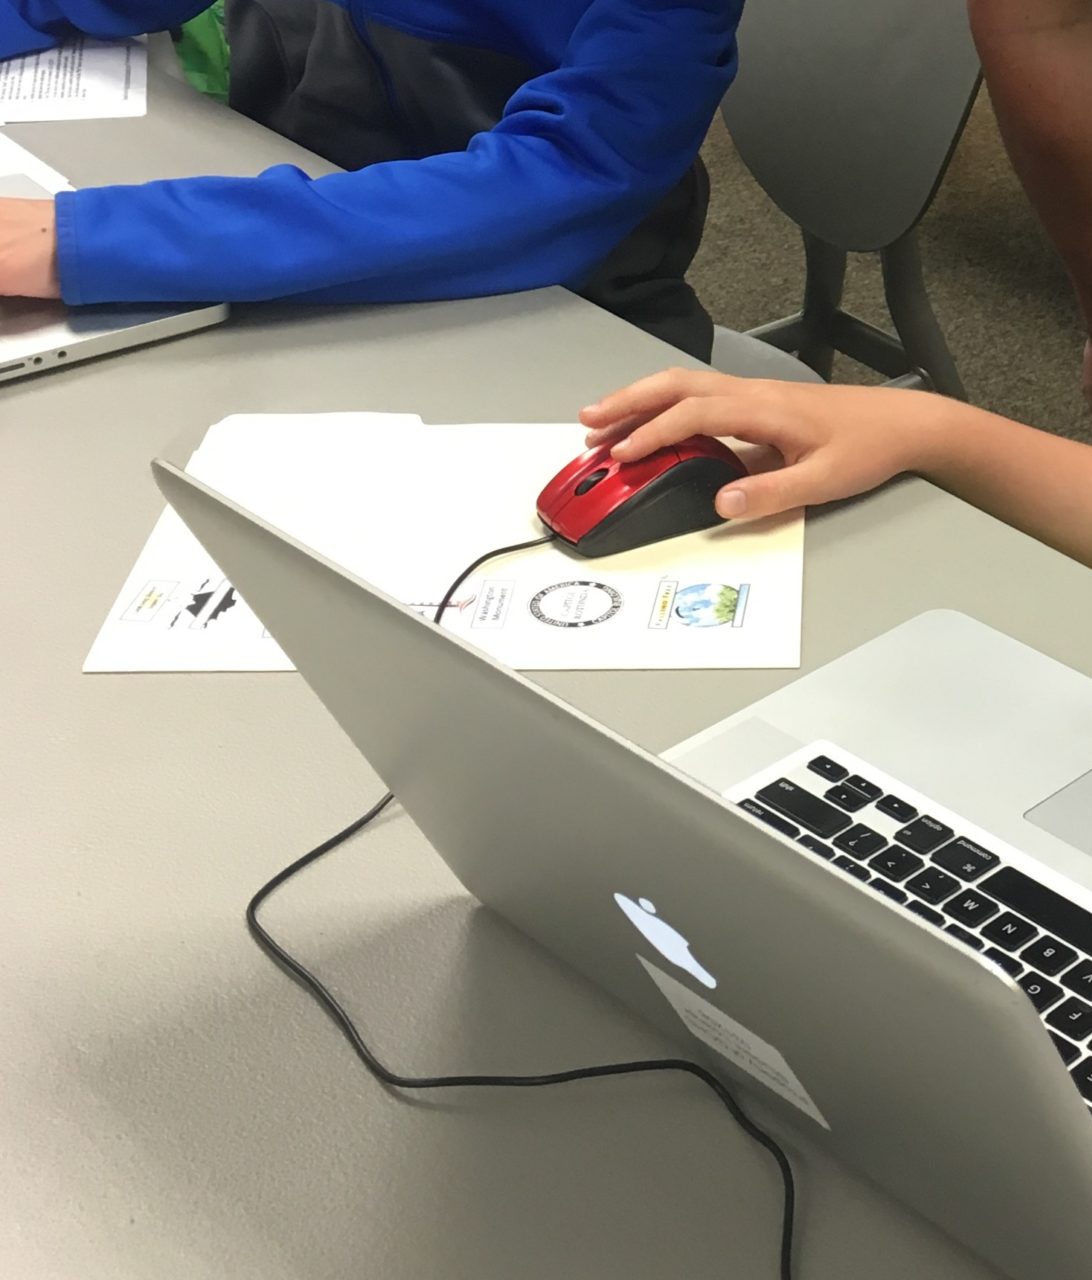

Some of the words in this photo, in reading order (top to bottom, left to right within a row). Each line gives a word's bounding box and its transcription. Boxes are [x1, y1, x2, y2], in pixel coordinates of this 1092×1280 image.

[957, 839, 992, 861] command
[962, 898, 980, 911] M
[1001, 923, 1018, 935] N
[1043, 948, 1056, 958] B
[1027, 984, 1041, 995] G
[1068, 1011, 1083, 1021] F
